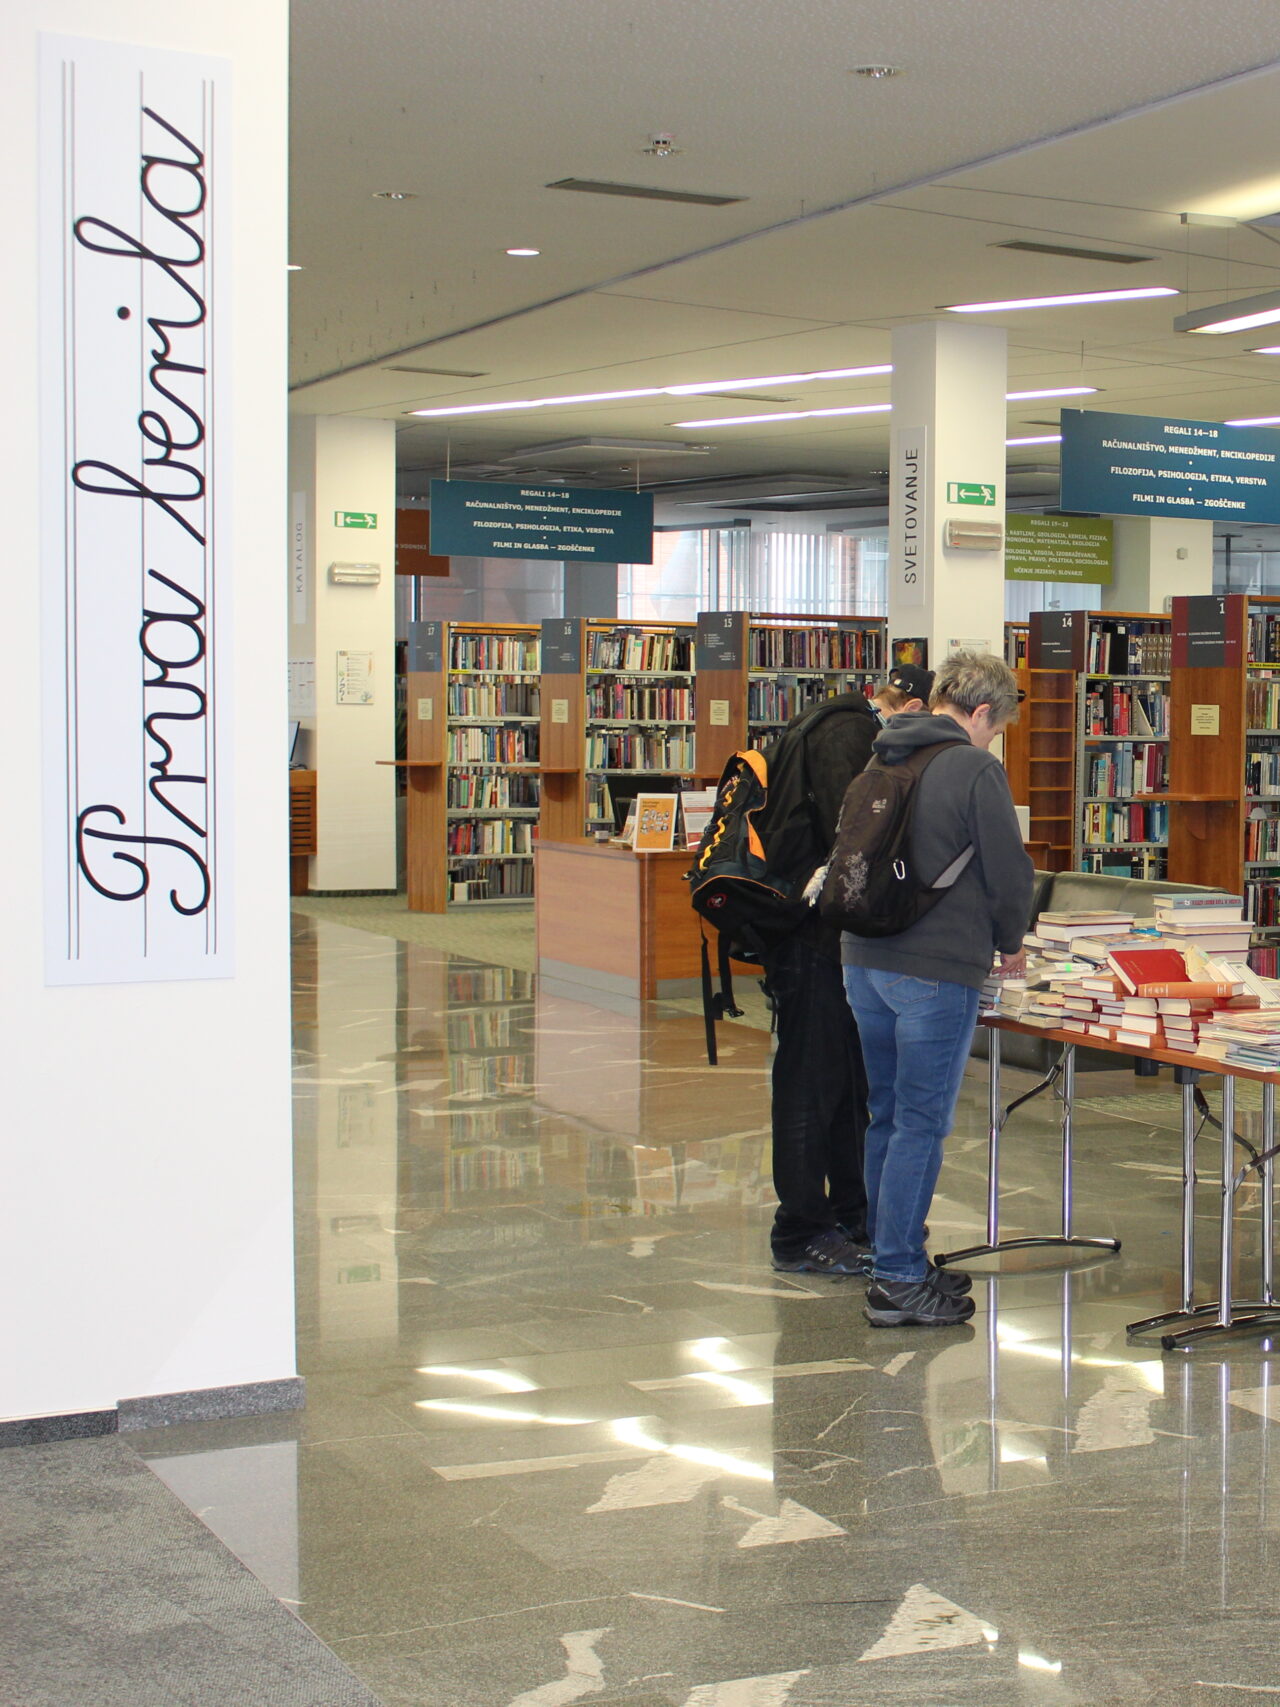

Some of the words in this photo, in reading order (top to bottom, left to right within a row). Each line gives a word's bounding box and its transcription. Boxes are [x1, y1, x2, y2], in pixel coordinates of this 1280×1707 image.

[72, 106, 208, 547] berila
[1164, 425, 1192, 436] REGALI
[1102, 438, 1167, 454] RAČUNALNIŠTVO,
[1169, 445, 1220, 459] MENEDŽMENT,
[1221, 450, 1276, 462] ENCIKLOPEDIJE
[1111, 466, 1156, 479] FILOZOFIJA,
[1158, 470, 1209, 482] PSIHOLOGIJA,
[1211, 474, 1234, 485] ETIKA,
[1236, 476, 1267, 486] VERSTVA
[520, 489, 546, 498] REGALI
[1133, 494, 1154, 503] FILMI
[1156, 495, 1165, 504] IN
[1167, 496, 1195, 506] GLASBA
[1204, 497, 1246, 509] ZGOŠČENKE
[466, 500, 524, 512] RAČUNALNIŠTVO,
[525, 503, 571, 514] MENEDŽMENT,
[572, 507, 622, 517] ENCIKLOPEDIJE
[904, 448, 918, 584] SVETOVANJE
[473, 520, 514, 530] FILOZOFIJA,
[515, 523, 561, 533] PSIHOLOGIJA,
[563, 526, 584, 534] ETIKA,
[585, 527, 614, 535] VERSTVA
[1030, 519, 1050, 527] REGALI
[493, 541, 512, 549] FILMI
[557, 544, 595, 553] ZGOŠČENKE
[1219, 602, 1225, 614] 1
[724, 618, 733, 628] 15
[1062, 617, 1072, 627] 14
[427, 627, 435, 636] 17
[564, 626, 572, 635] 16
[75, 568, 211, 916] Prva
